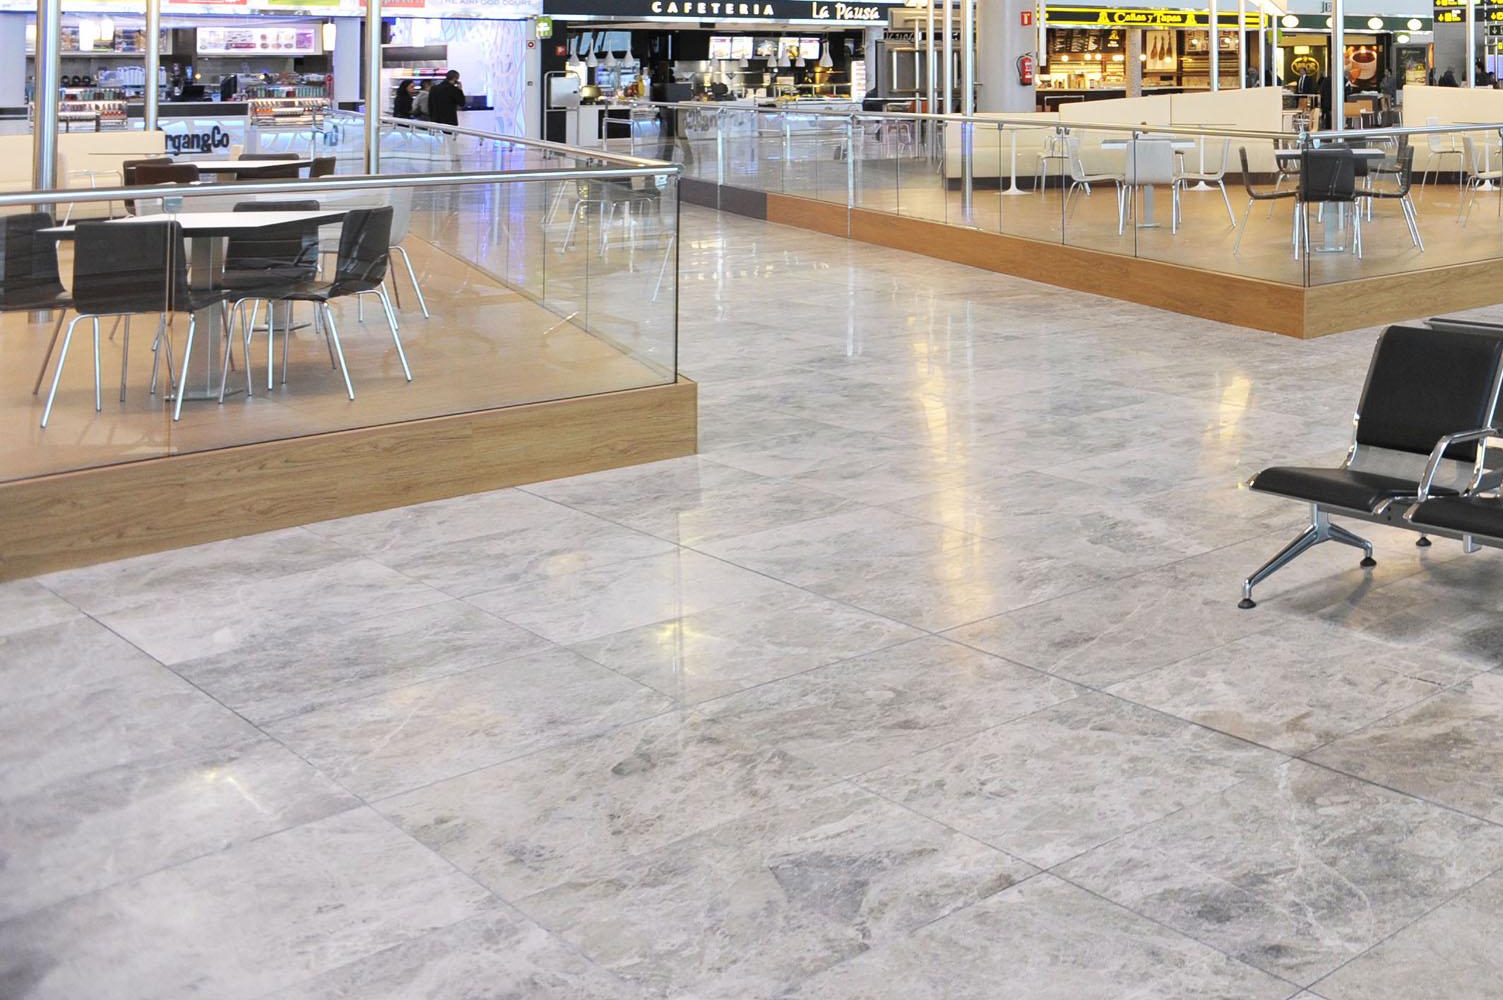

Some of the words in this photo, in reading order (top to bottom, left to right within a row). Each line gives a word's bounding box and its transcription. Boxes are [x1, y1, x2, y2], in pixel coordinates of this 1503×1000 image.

[651, 1, 774, 16] CAFETERIA
[812, 2, 830, 19] La
[835, 2, 880, 20] Pausa
[158, 125, 230, 156] rgan&Co
